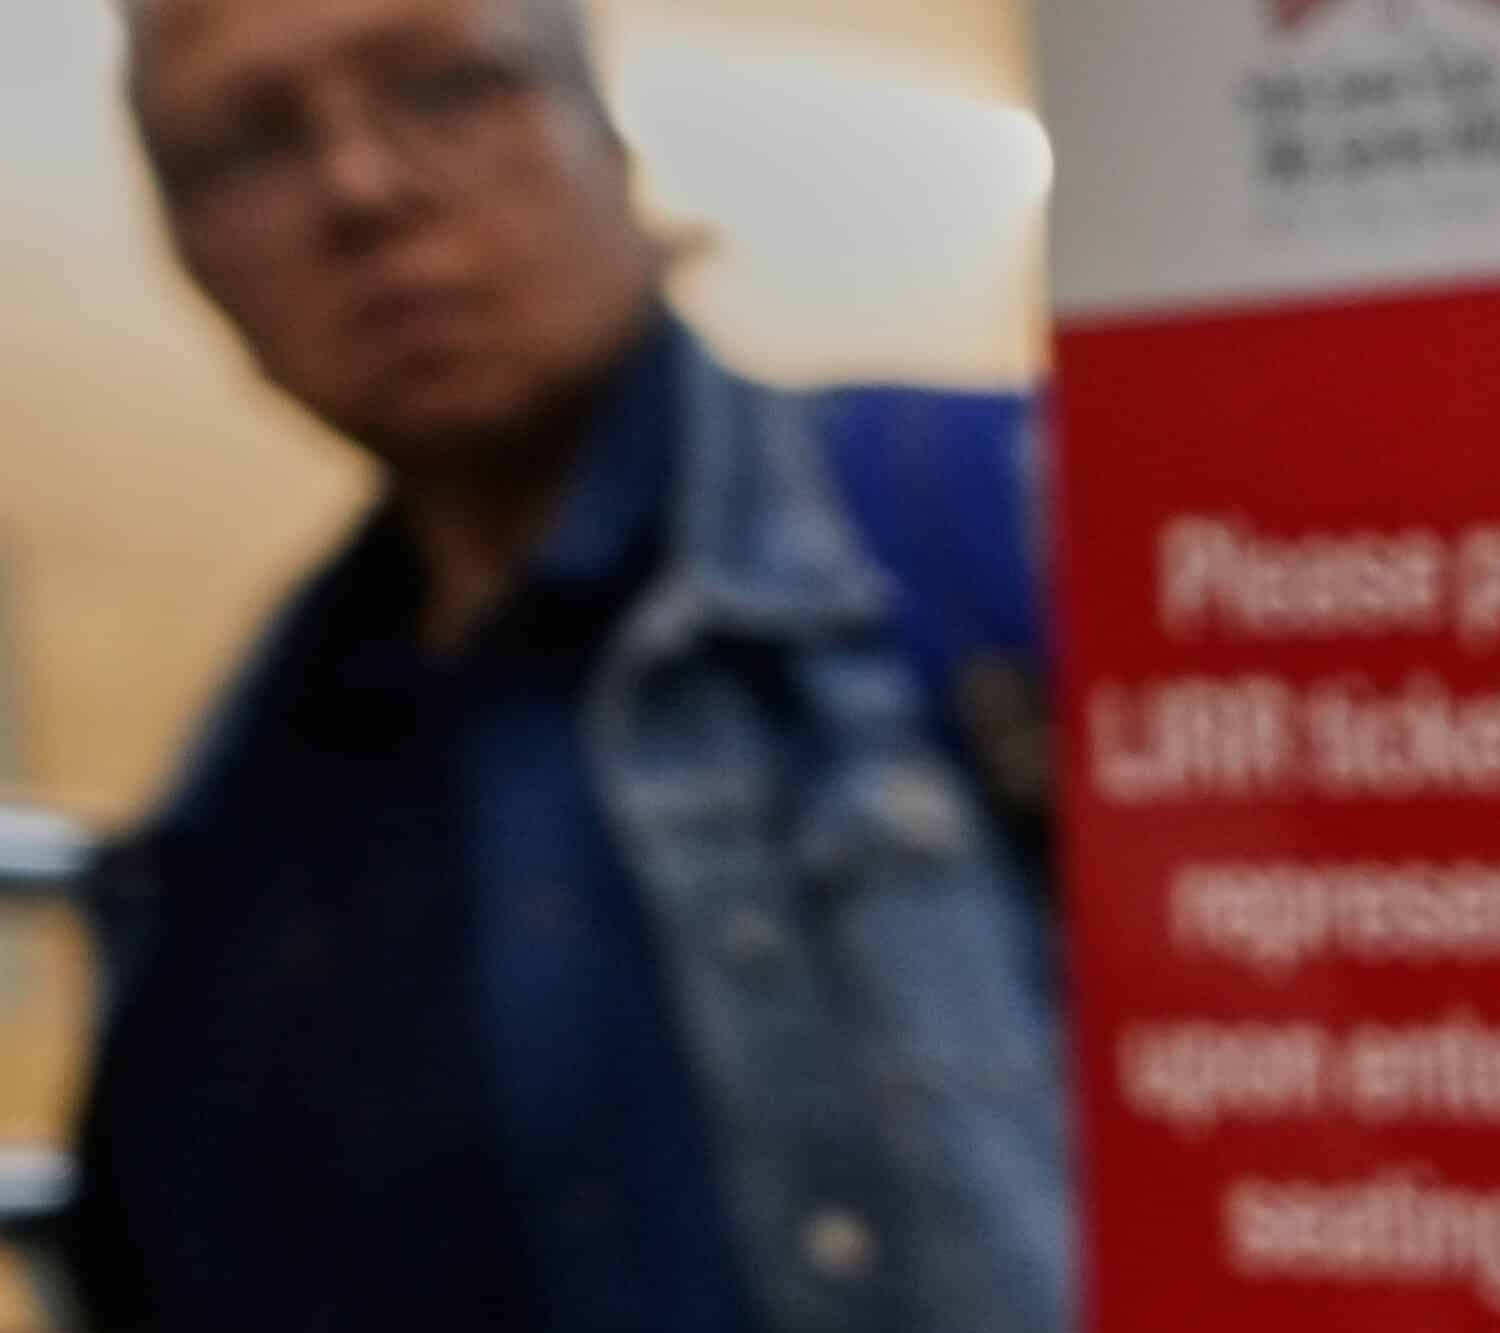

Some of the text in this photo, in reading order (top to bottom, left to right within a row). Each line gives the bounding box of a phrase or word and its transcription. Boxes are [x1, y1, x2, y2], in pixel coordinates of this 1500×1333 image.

[1163, 515, 1445, 635] Please
[1090, 680, 1292, 800] LIRR
[1120, 1026, 1324, 1132] upon
